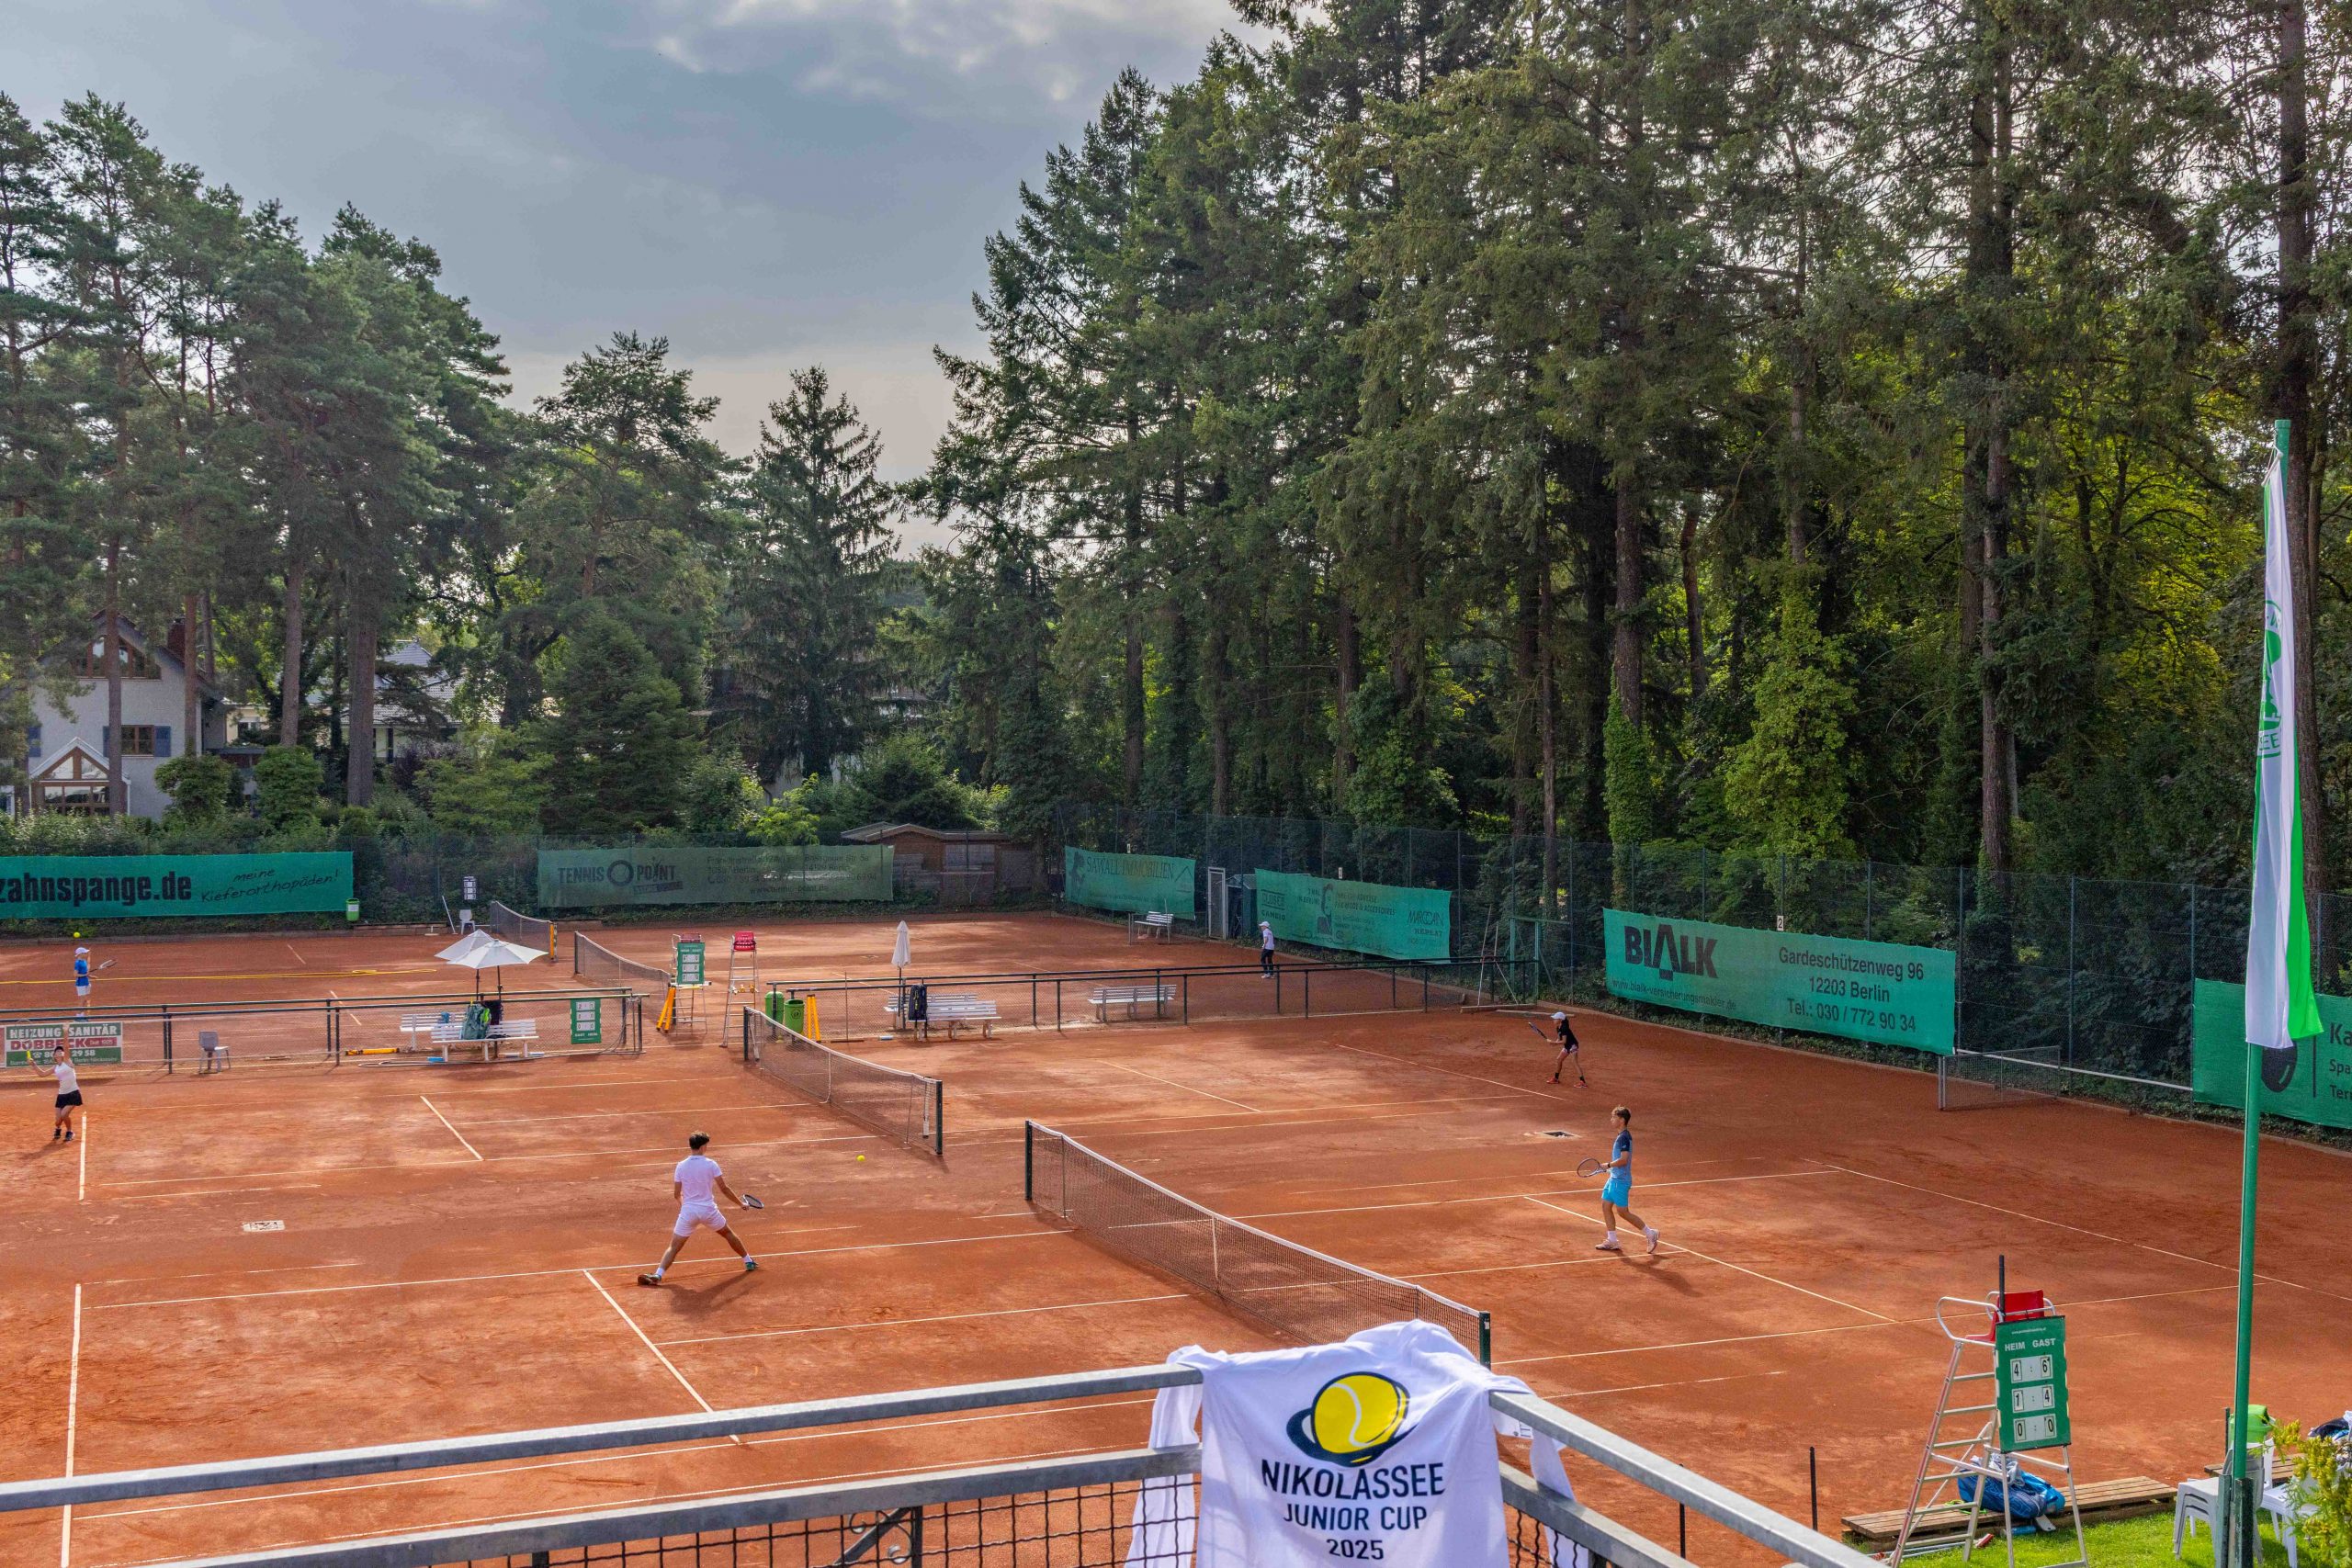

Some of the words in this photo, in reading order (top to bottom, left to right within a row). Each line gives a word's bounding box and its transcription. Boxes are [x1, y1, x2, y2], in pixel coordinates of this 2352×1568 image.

[232, 869, 276, 882] meine
[558, 866, 605, 883] TENNIS
[1087, 856, 1119, 875] SAWALL
[1122, 858, 1174, 879] IMMOBILIEN
[1778, 919, 1783, 928] 2
[1624, 924, 1719, 981] BIALK
[1779, 946, 1904, 982] Gardeschützenweg
[1907, 963, 1924, 980] 96
[1809, 976, 1846, 997] 12203
[1850, 981, 1890, 1002] Berlin
[1787, 998, 1813, 1017] Tel.:
[1816, 1002, 1839, 1021] 030
[1850, 1007, 1875, 1026] 772
[1879, 1012, 1896, 1030] 90
[1900, 1014, 1917, 1032] 34
[9, 1027, 62, 1040] HEIZUNG
[68, 1023, 118, 1037] SANITÄR
[2004, 1342, 2026, 1352] HEIM
[2031, 1338, 2056, 1348] GAST
[2014, 1363, 2019, 1377] 4
[2041, 1359, 2048, 1373] 6
[2044, 1389, 2050, 1403] 4
[2017, 1423, 2023, 1437] 0
[2048, 1418, 2053, 1433] 0
[1261, 1459, 1446, 1500] NIKOLASSEE
[1283, 1504, 1369, 1530] JUNIOR
[1381, 1506, 1427, 1530] CUP
[1326, 1539, 1384, 1560] 2025
